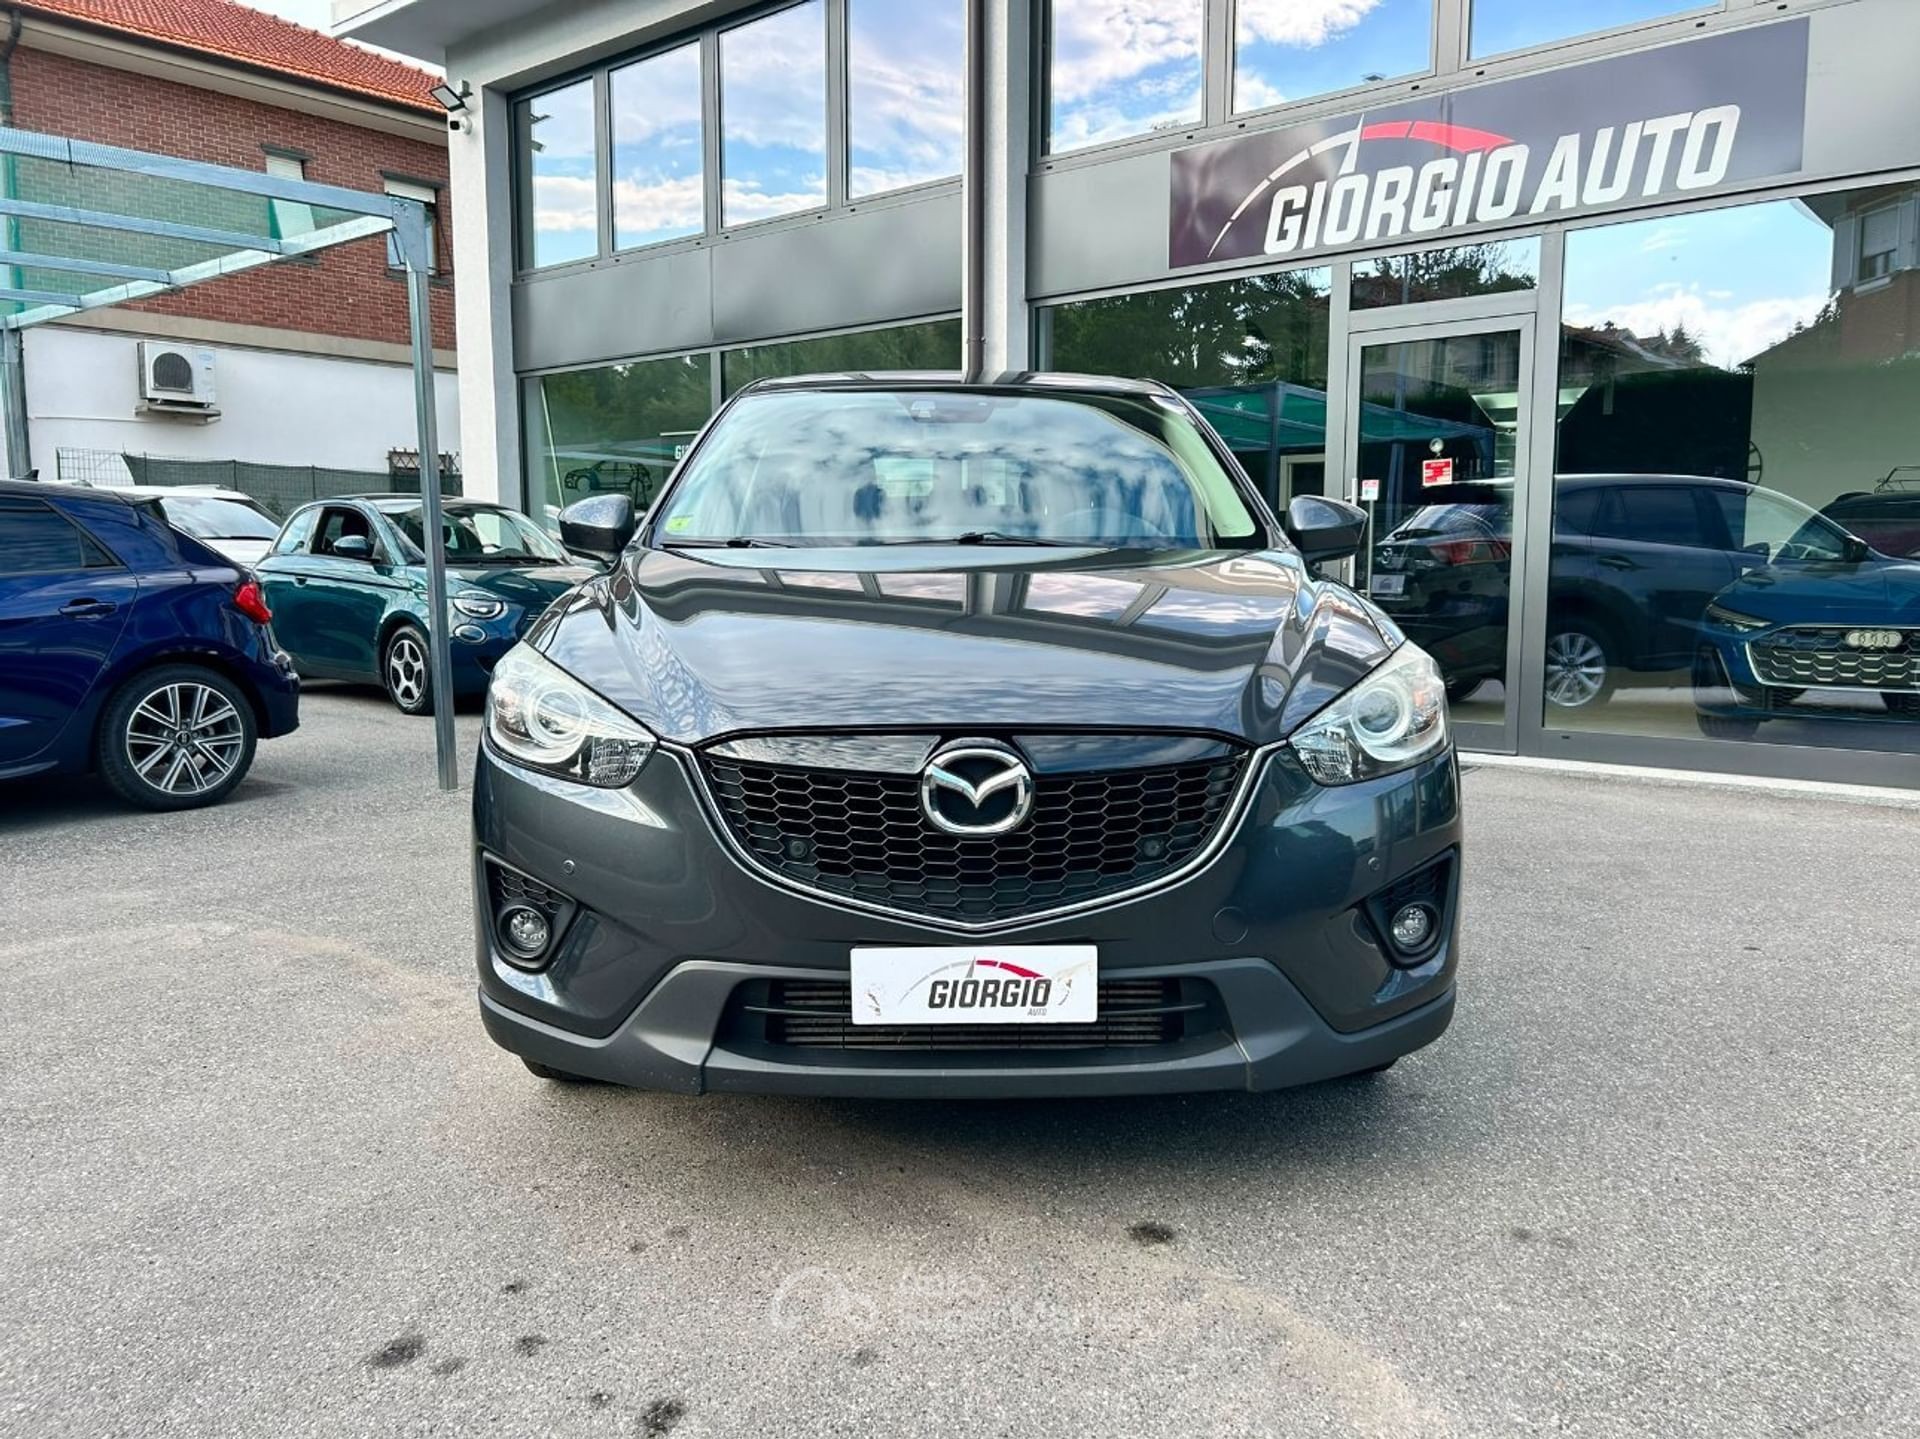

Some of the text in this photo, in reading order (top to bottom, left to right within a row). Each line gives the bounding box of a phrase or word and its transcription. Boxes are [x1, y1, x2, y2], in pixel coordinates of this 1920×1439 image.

[1263, 105, 1740, 255] GIORGIO AUTO
[928, 978, 1052, 1009] GIORGIO
[1027, 1008, 1048, 1017] AUTO
